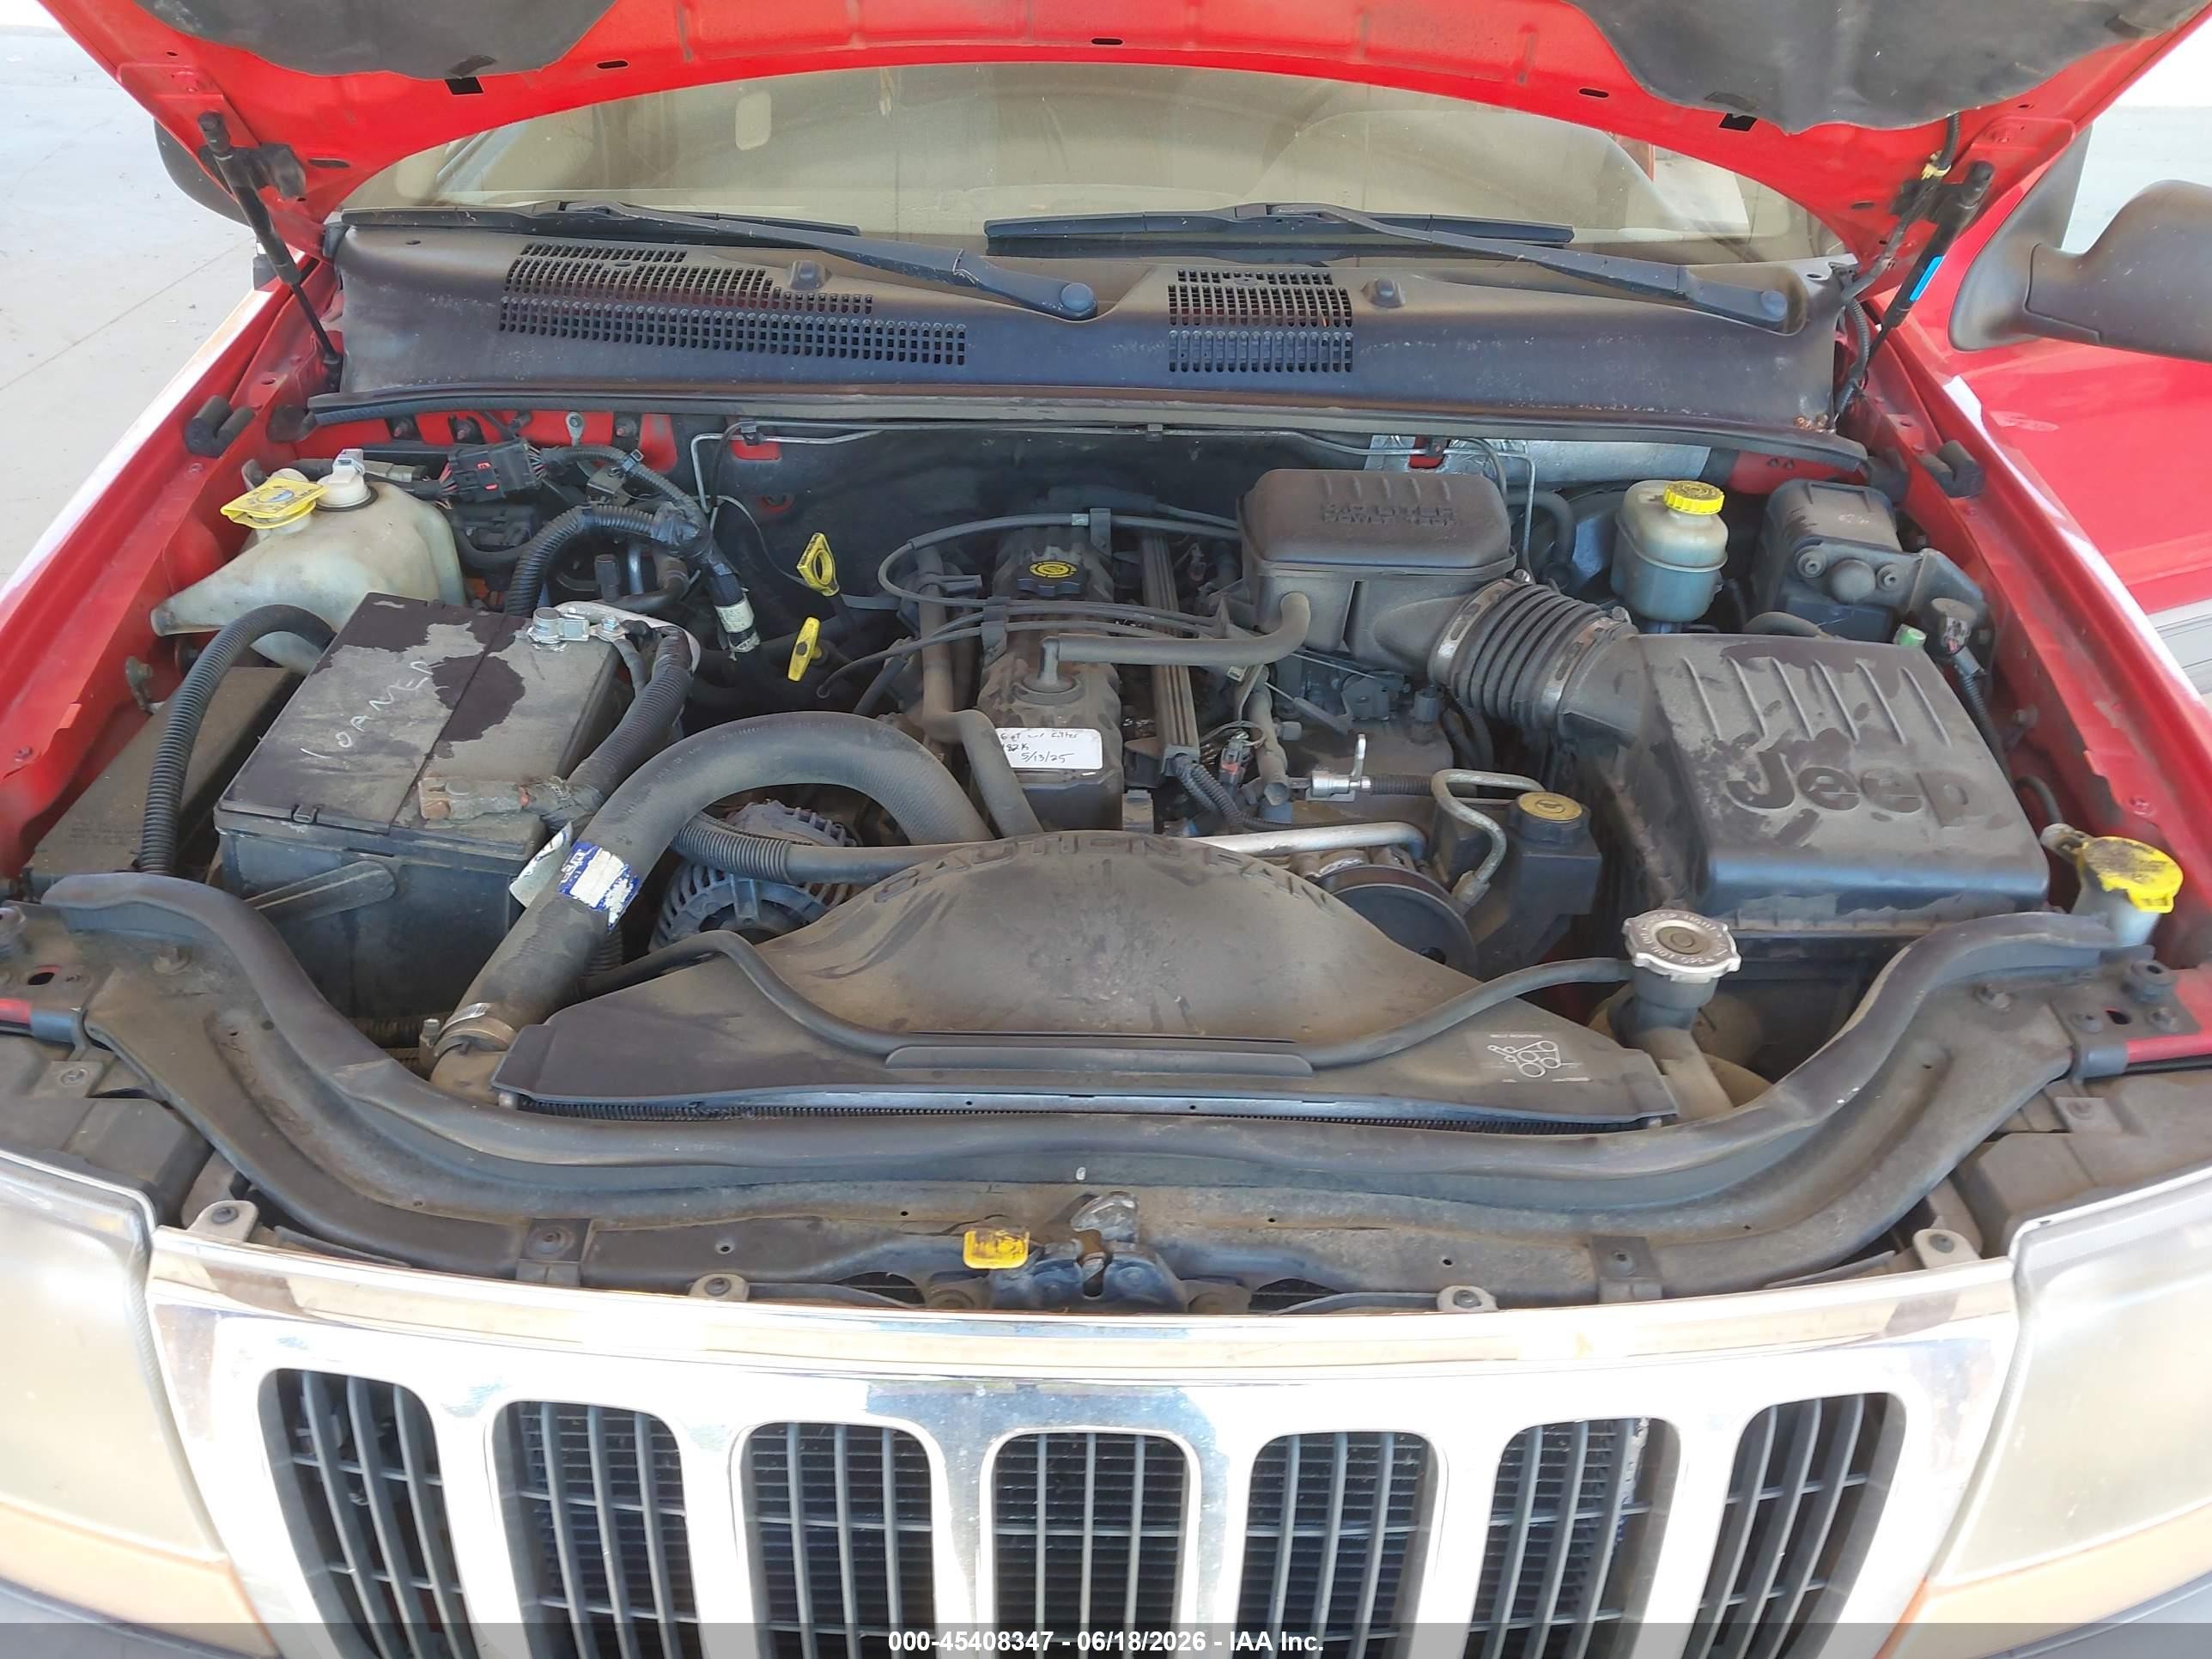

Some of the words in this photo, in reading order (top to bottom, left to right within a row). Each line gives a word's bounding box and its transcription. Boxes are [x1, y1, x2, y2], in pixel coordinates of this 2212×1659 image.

[1021, 750, 1074, 763] 5/13/25
[1724, 749, 1985, 829] Jeep
[873, 833, 1182, 902] CAUTION
[1202, 844, 1340, 918] FAN
